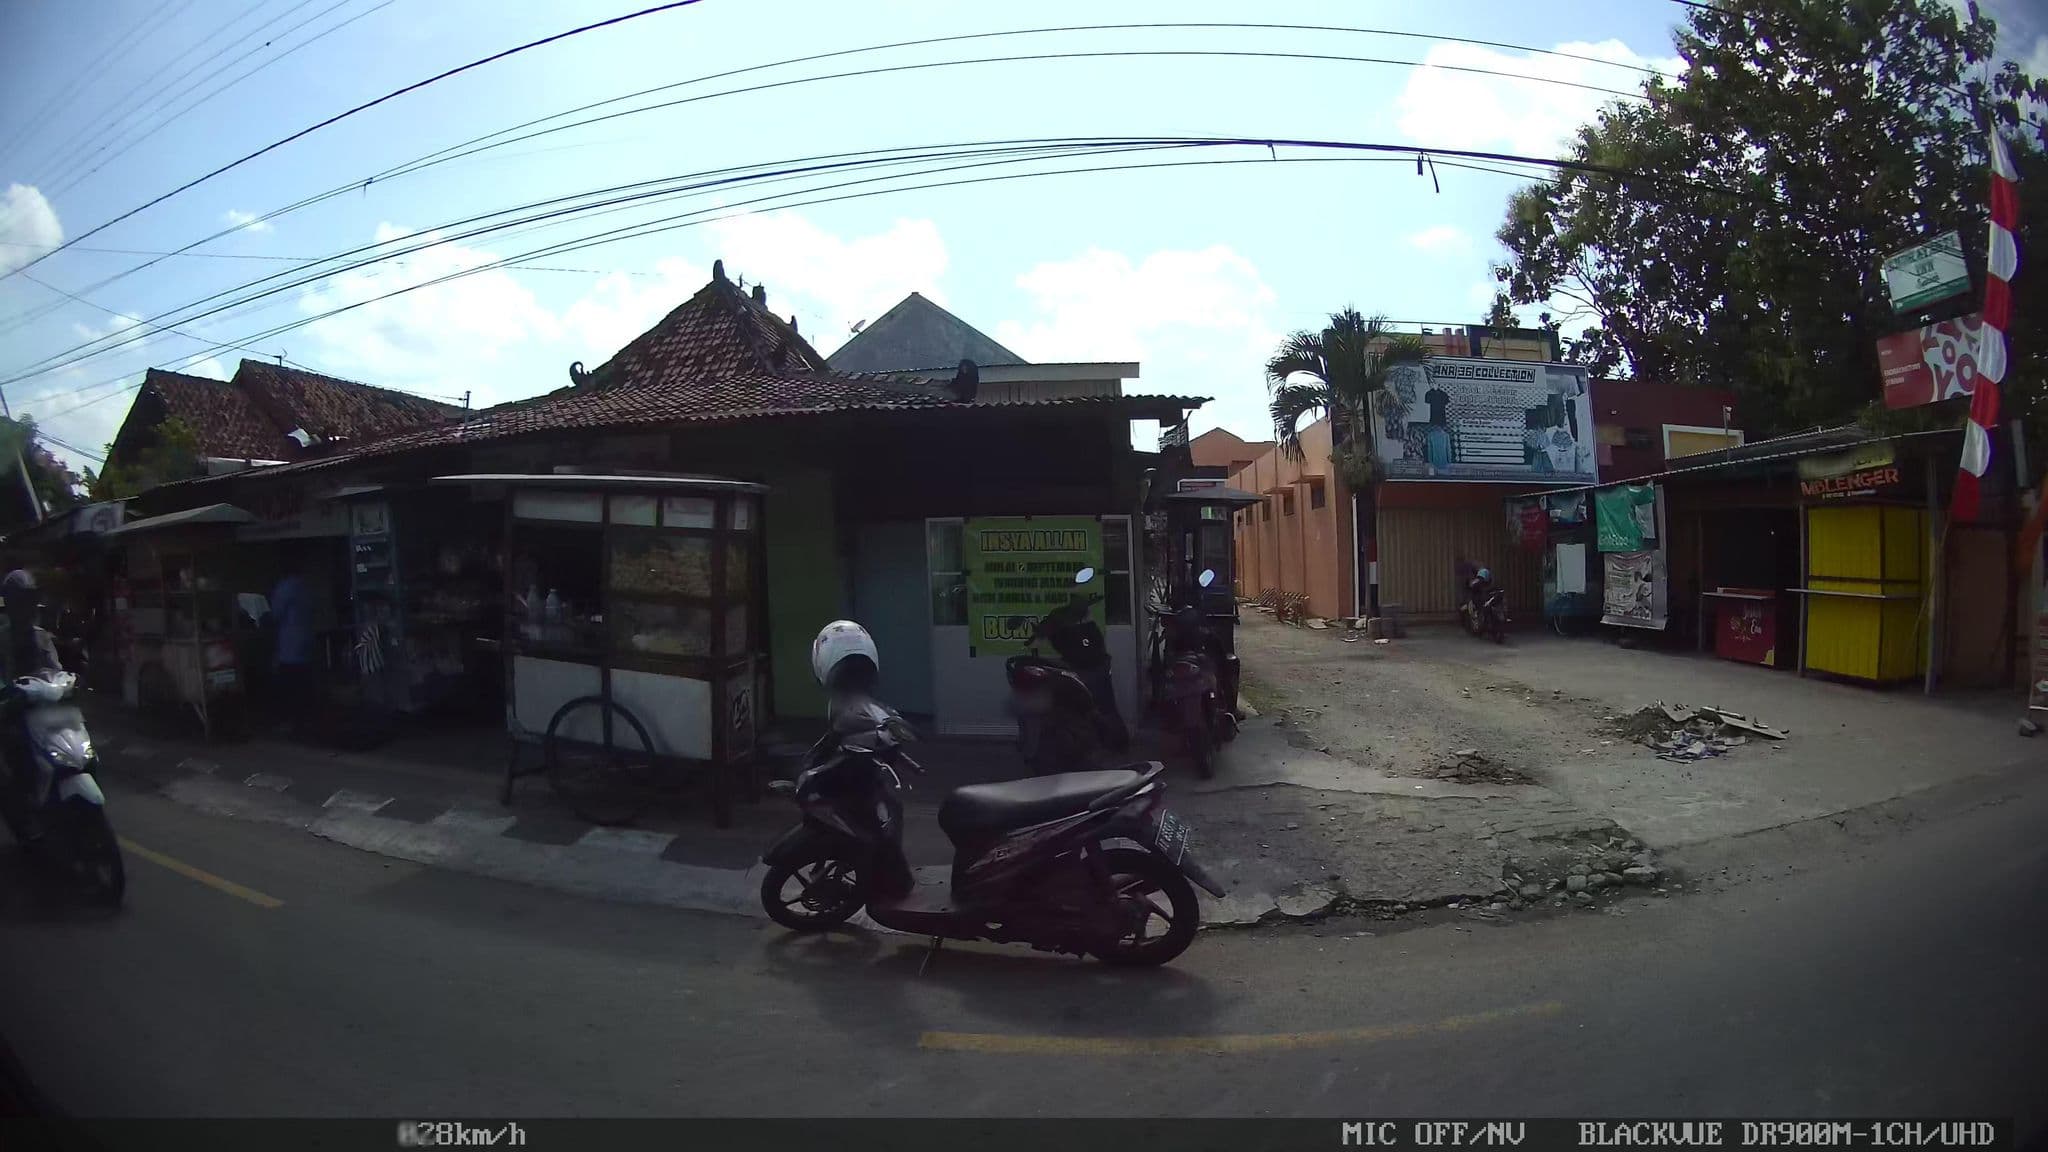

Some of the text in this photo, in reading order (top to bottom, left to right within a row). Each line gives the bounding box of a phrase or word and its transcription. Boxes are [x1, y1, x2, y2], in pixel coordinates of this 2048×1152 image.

[1457, 365, 1474, 379] 36
[1475, 366, 1535, 382] COLLECTION
[980, 529, 1088, 552] INSYA ALLAH
